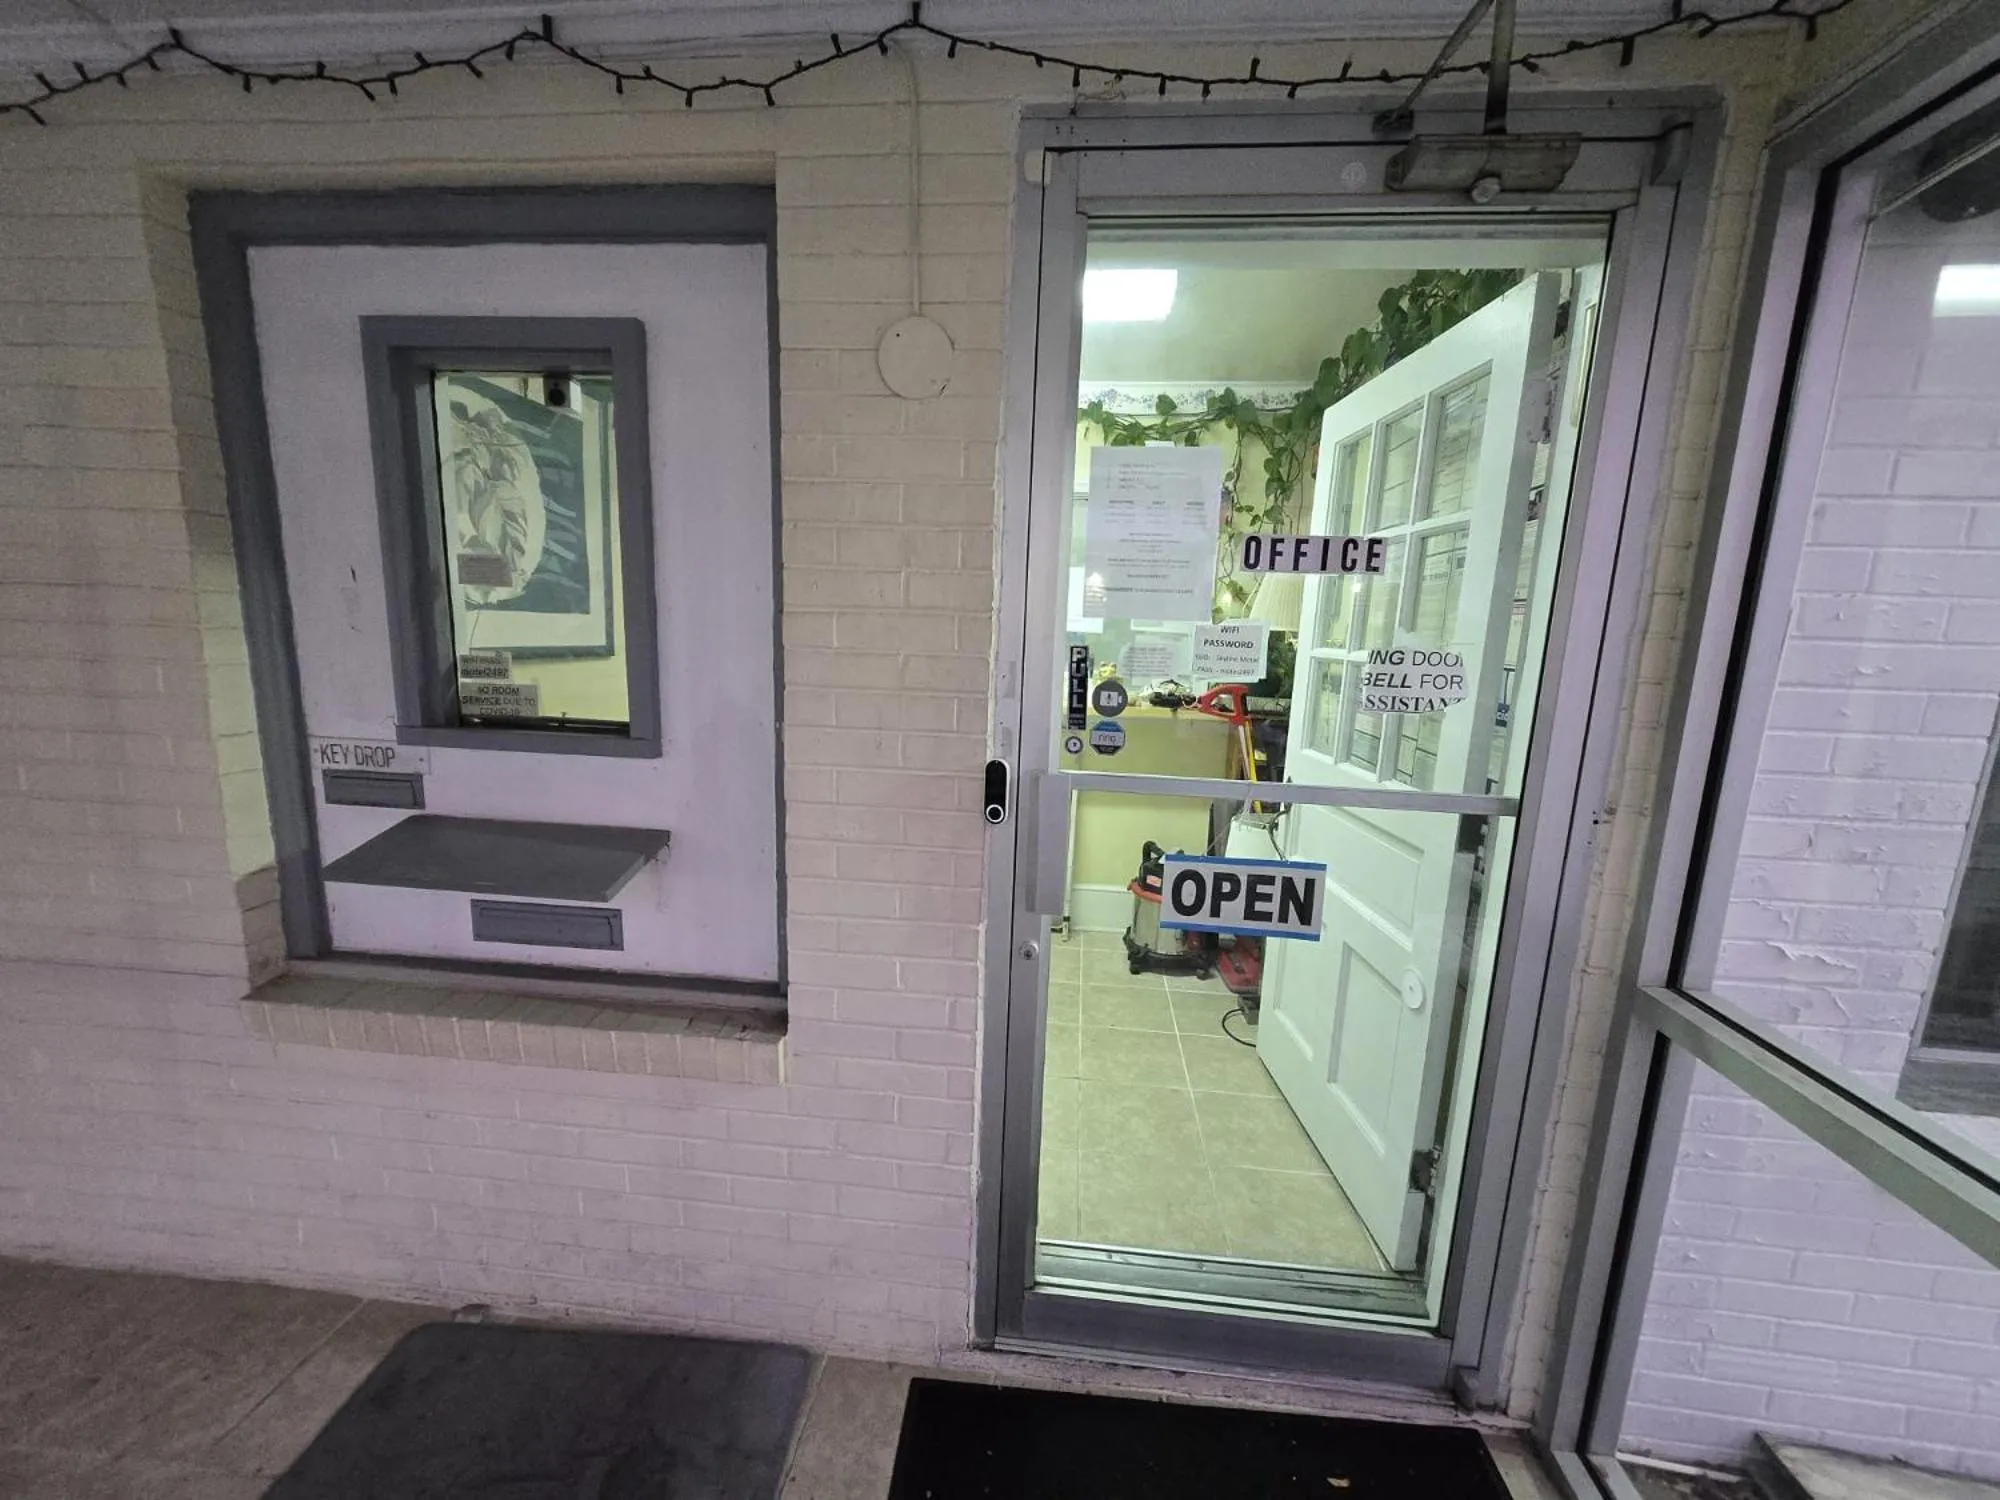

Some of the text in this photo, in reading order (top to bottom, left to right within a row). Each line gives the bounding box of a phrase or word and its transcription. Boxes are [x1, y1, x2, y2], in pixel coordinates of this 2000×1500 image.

[1243, 535, 1383, 573] OFFICE
[1220, 625, 1240, 634] WIFI
[1203, 638, 1254, 649] PASSWORD
[1368, 650, 1463, 668] ING DOO
[1071, 647, 1086, 708] PULL
[1420, 674, 1463, 690] FOR
[1364, 694, 1466, 713] SSISTAN
[320, 743, 395, 769] KEY DROP
[1171, 868, 1316, 927] OPEN
